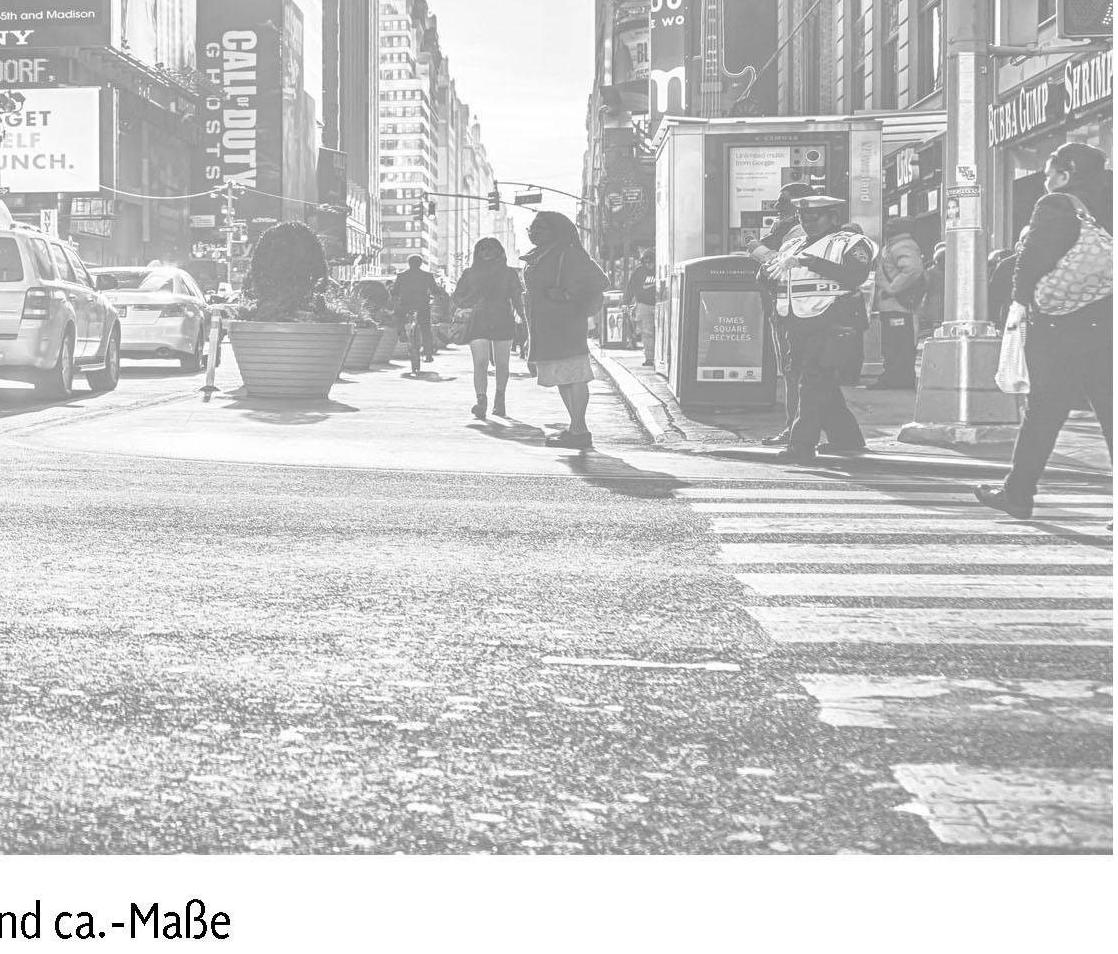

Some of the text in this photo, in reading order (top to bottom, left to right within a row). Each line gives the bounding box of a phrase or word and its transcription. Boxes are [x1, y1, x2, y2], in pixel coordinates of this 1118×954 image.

[20, 10, 44, 21] and
[46, 8, 95, 20] Madison
[222, 30, 258, 188] CALL OF DUTY
[988, 97, 1018, 148] BUBBA
[1018, 82, 1050, 134] GUMP
[4, 110, 52, 127] GET
[718, 316, 745, 325] TIMES
[713, 325, 748, 334] SQUARE
